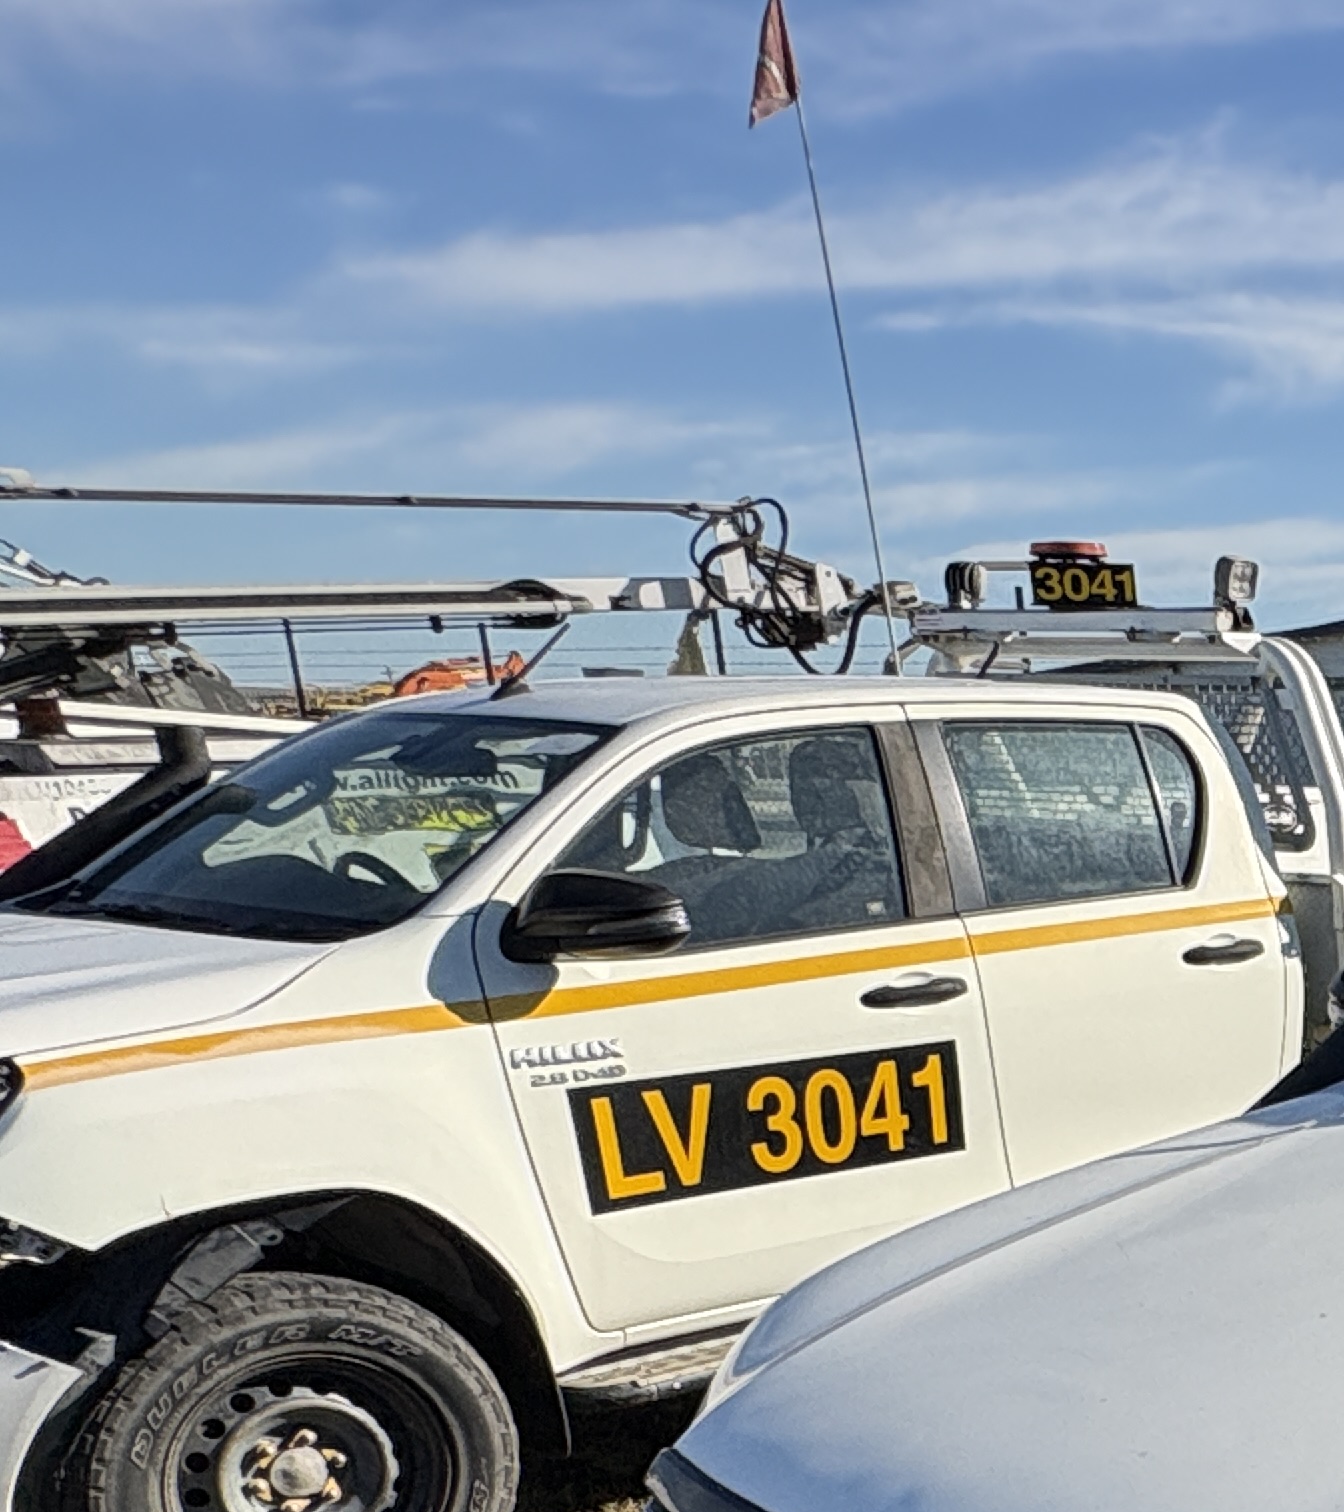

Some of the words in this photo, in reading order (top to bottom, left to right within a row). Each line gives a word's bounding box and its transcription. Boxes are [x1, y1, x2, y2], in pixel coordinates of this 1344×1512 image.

[1034, 566, 1135, 603] 3041
[509, 1038, 624, 1069] HILUX
[590, 1083, 712, 1200] LV
[746, 1053, 948, 1174] 3041
